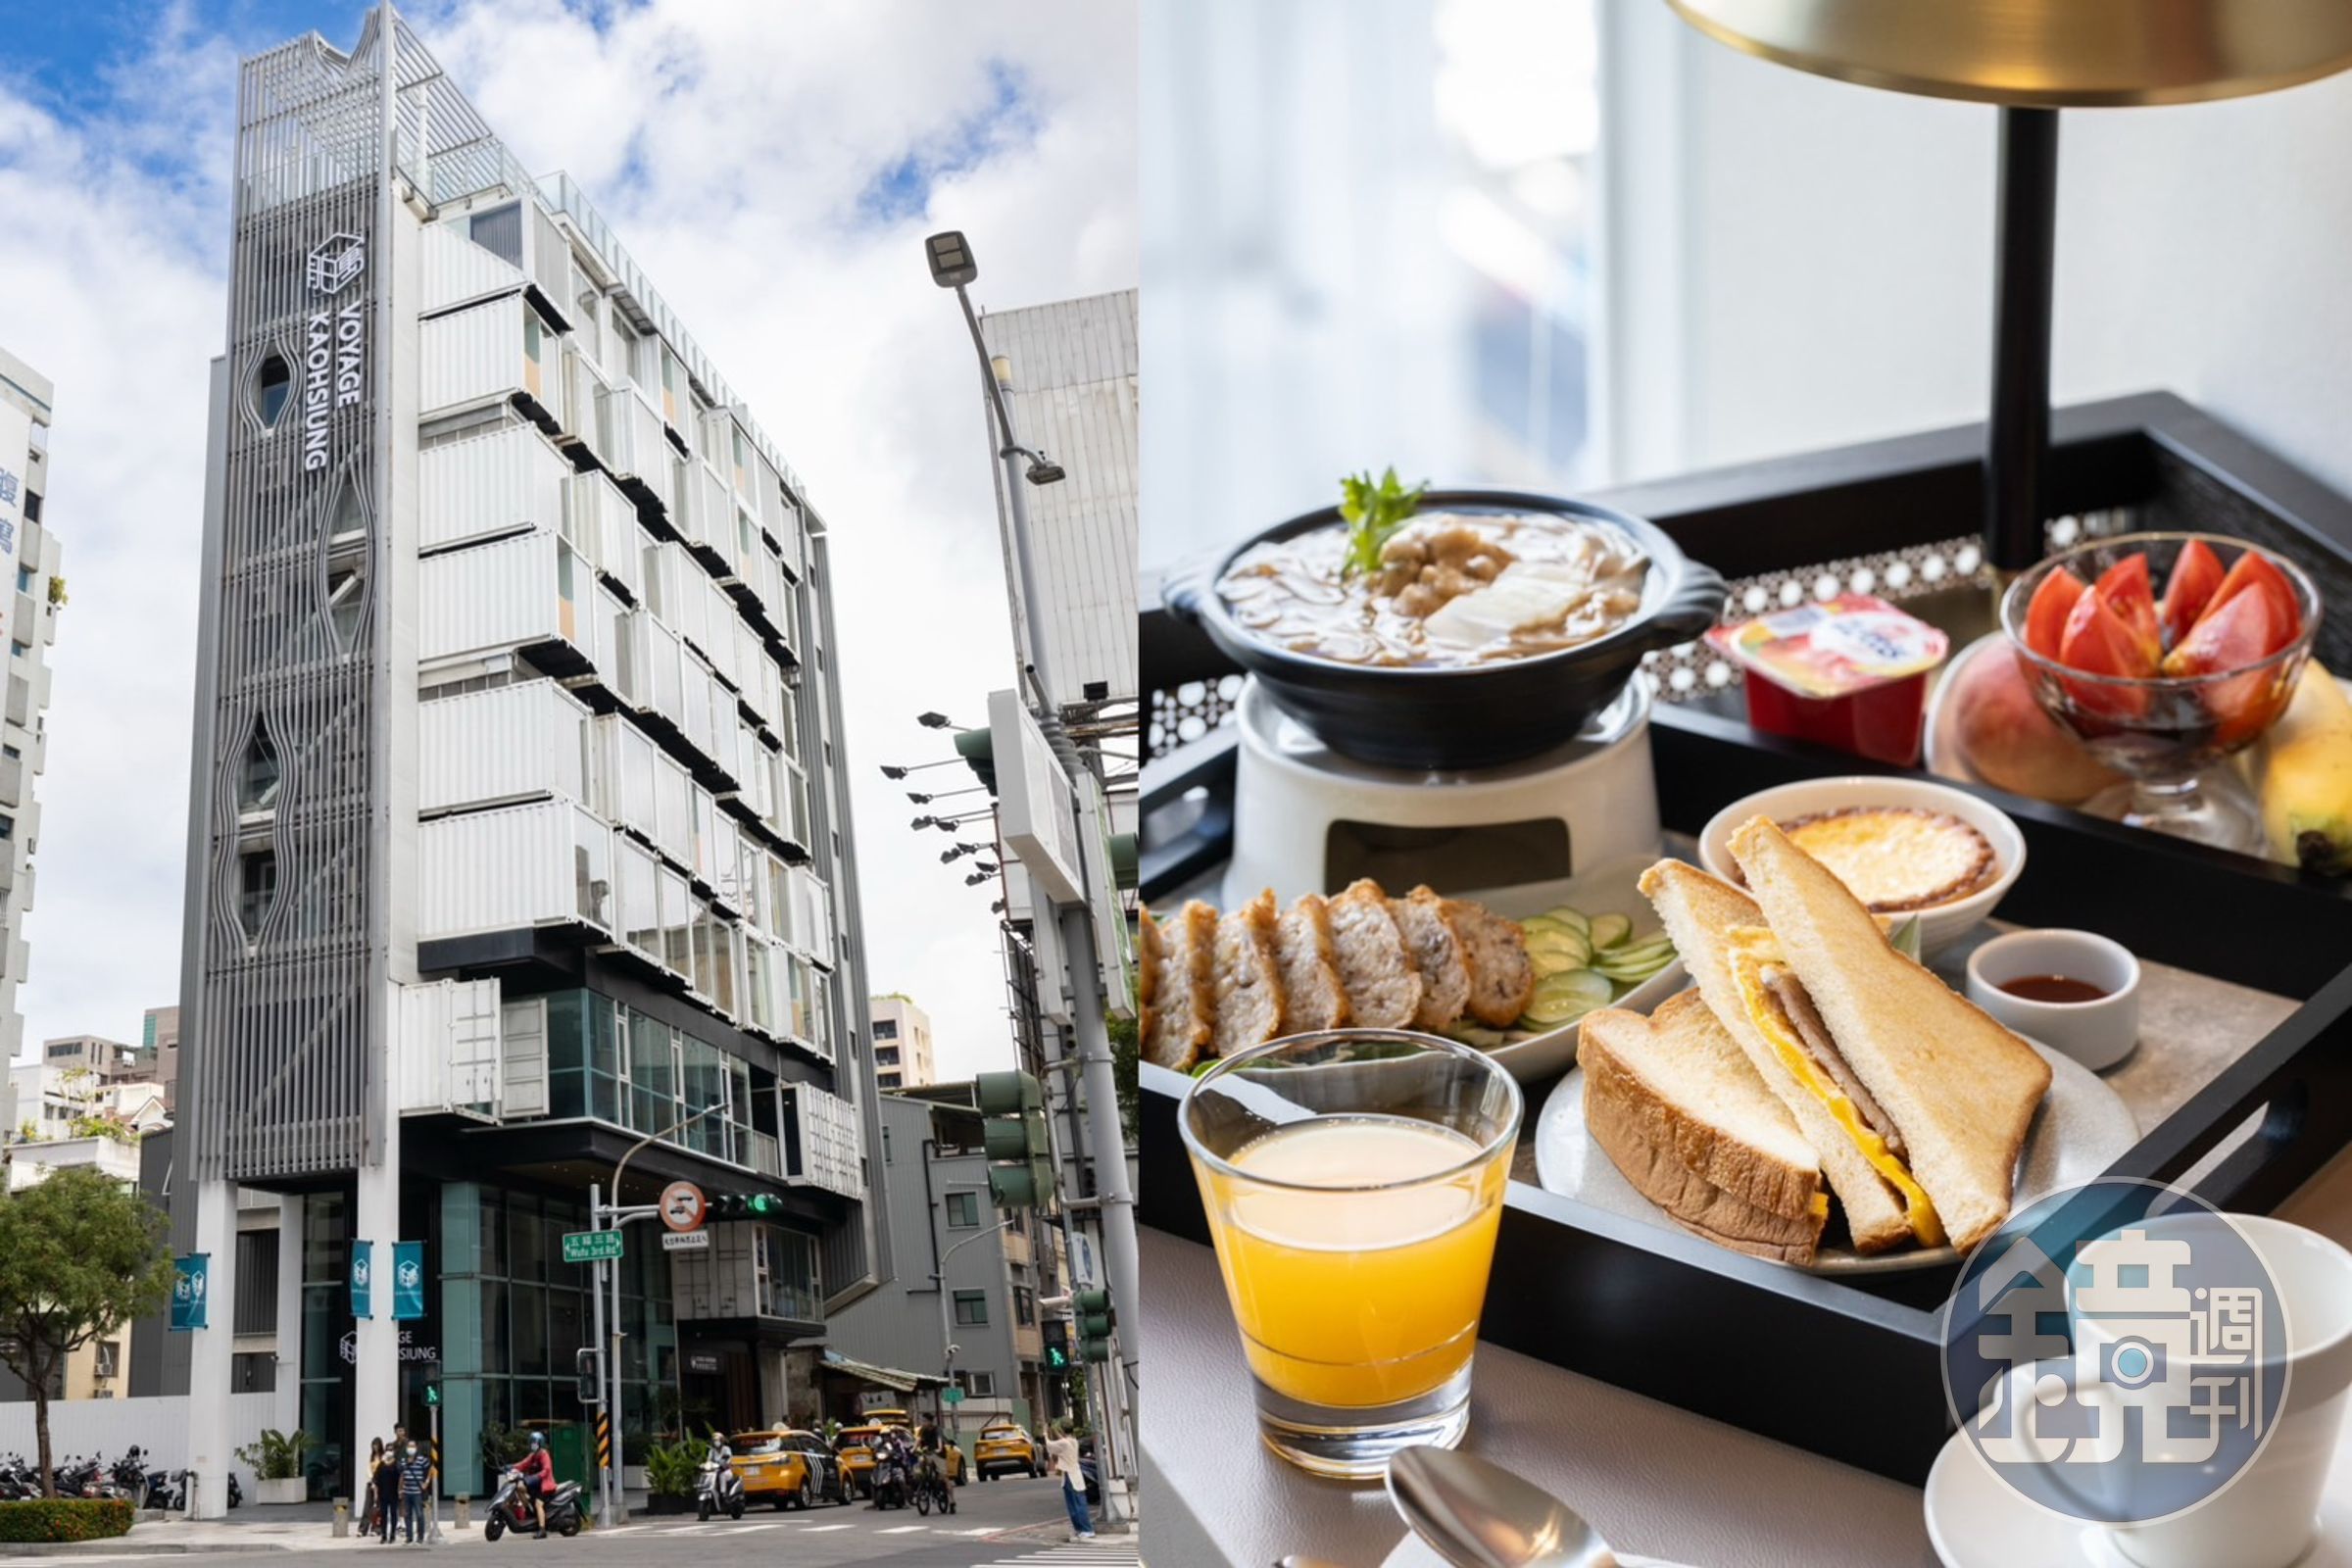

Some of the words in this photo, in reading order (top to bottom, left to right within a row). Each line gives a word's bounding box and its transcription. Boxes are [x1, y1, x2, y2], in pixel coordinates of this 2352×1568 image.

[305, 311, 330, 472] KAOHSIUNG
[338, 300, 362, 409] VOYAGE
[398, 1347, 436, 1360] SIUNG
